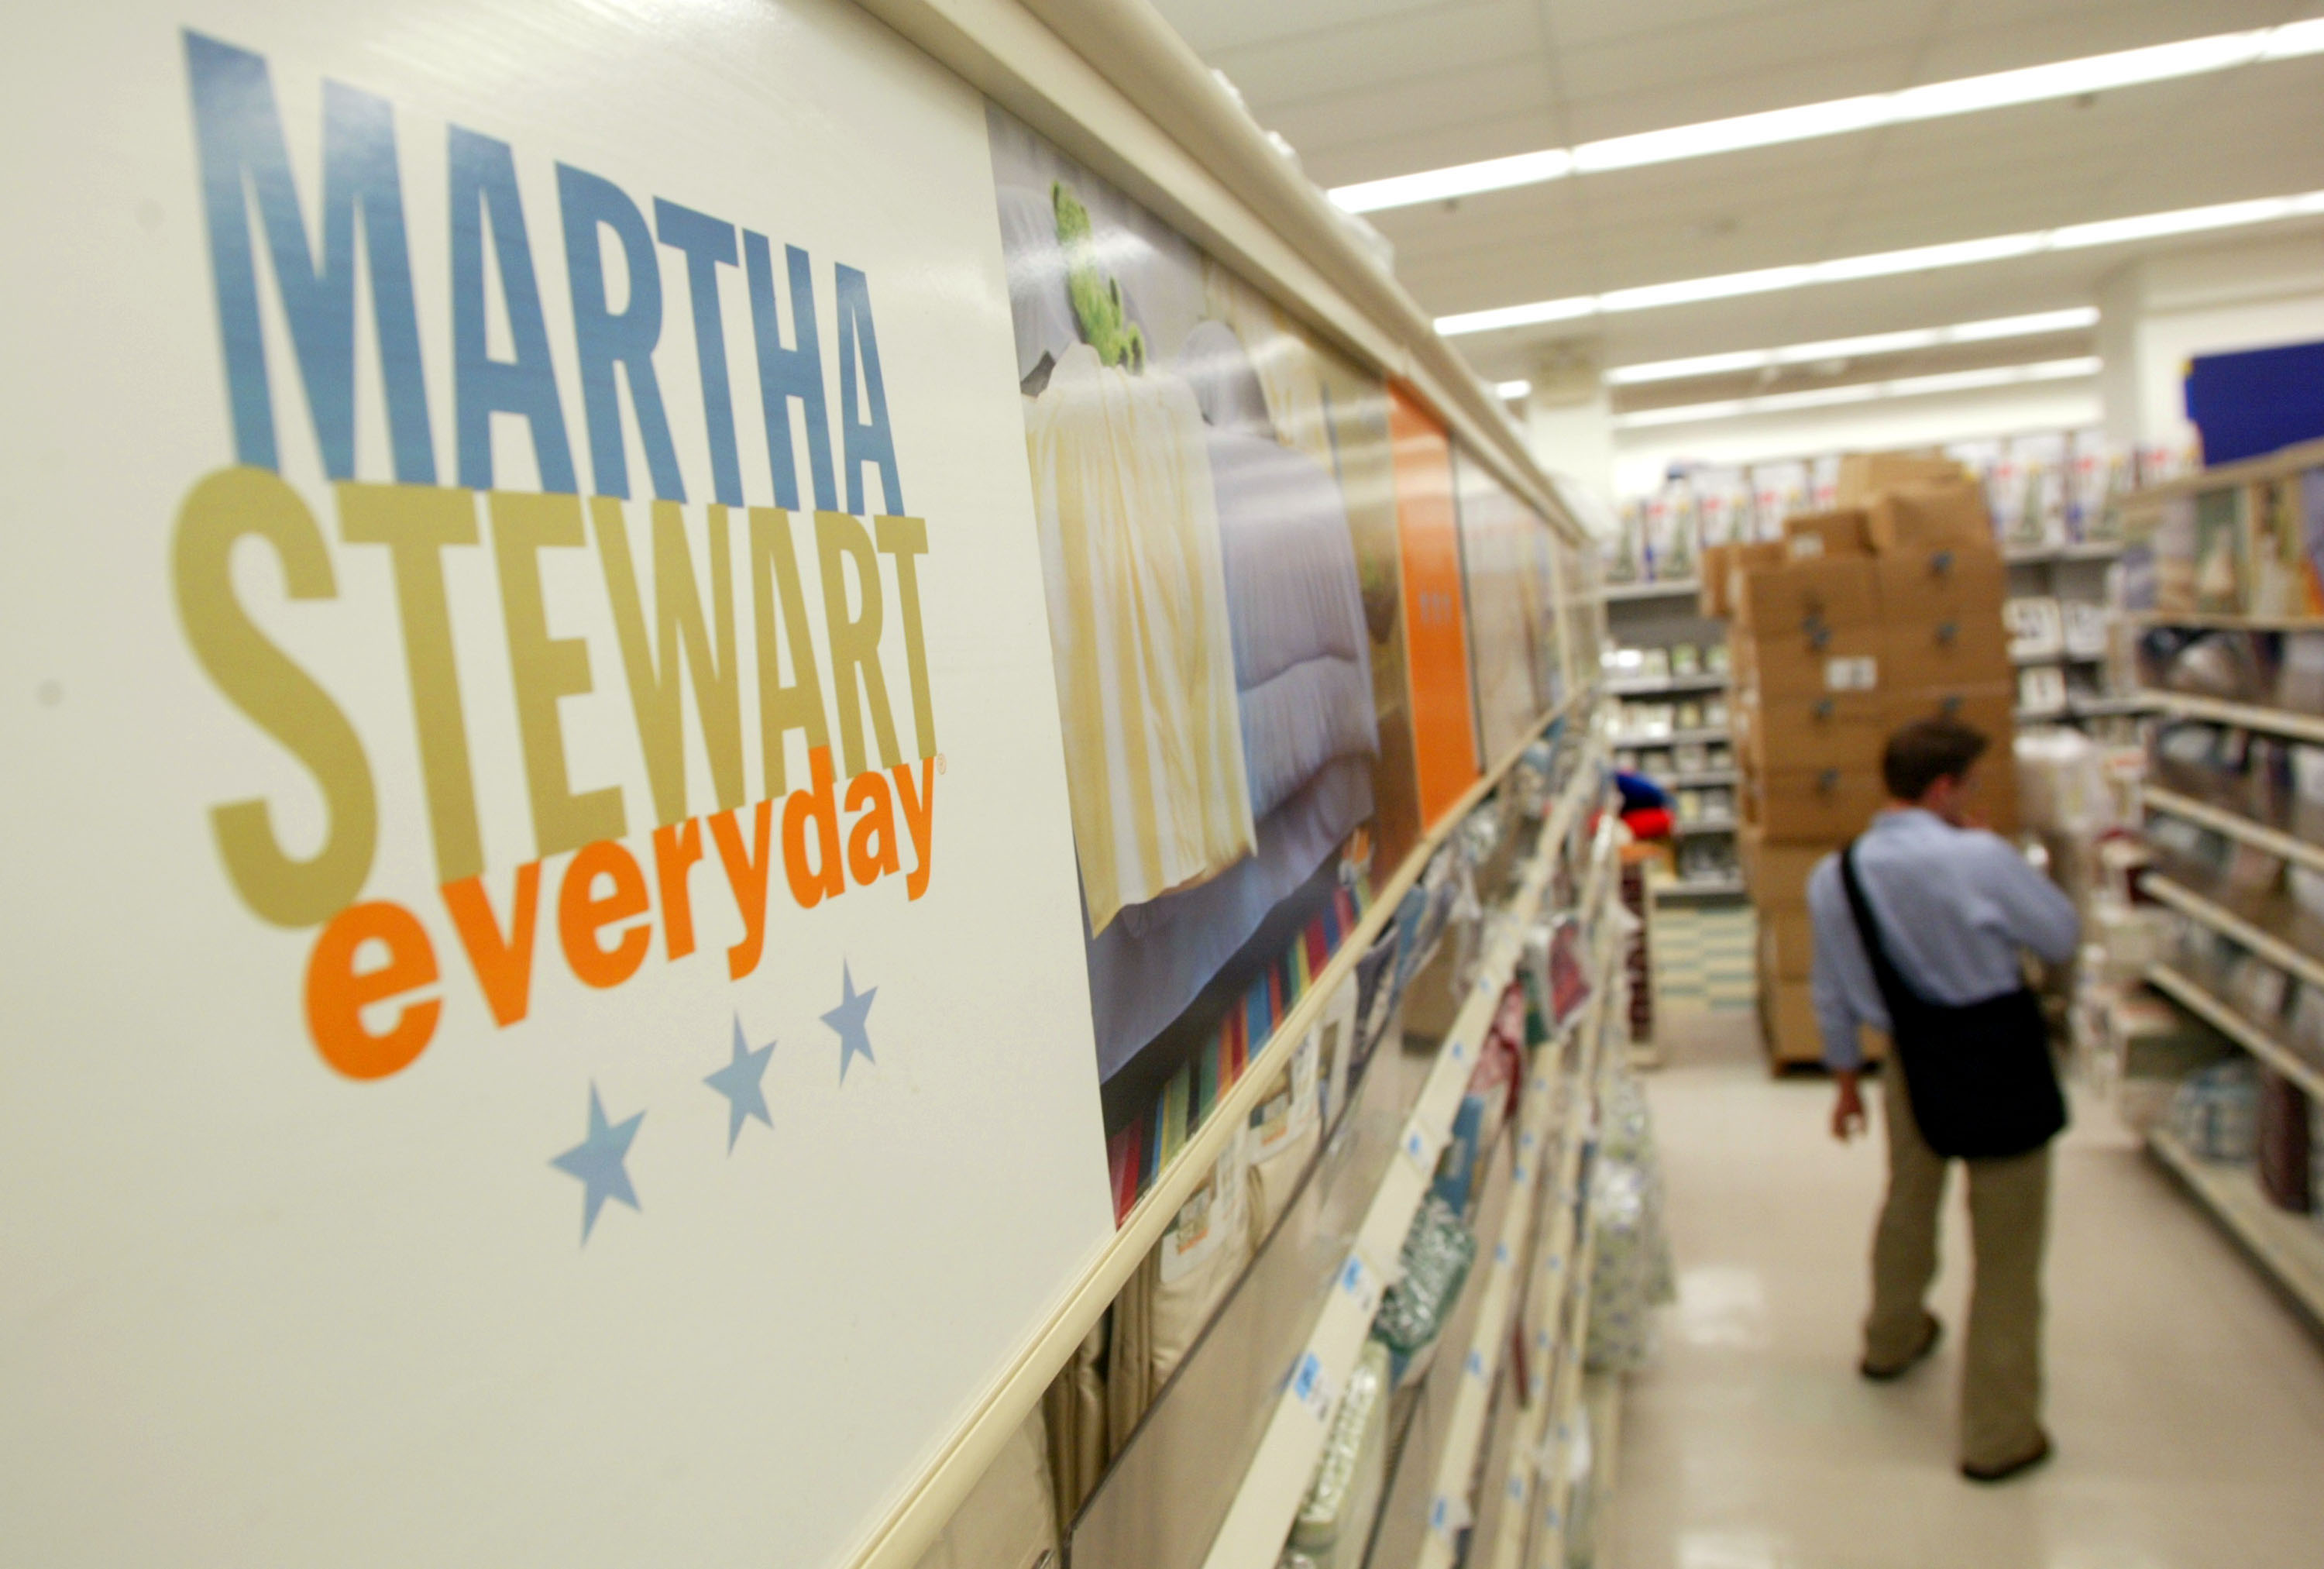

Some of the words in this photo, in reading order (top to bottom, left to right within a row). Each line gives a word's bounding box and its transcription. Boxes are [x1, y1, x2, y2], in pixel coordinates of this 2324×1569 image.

[183, 28, 905, 516] MARTHA
[169, 465, 937, 931] STEWART
[302, 745, 934, 1082] everyday
